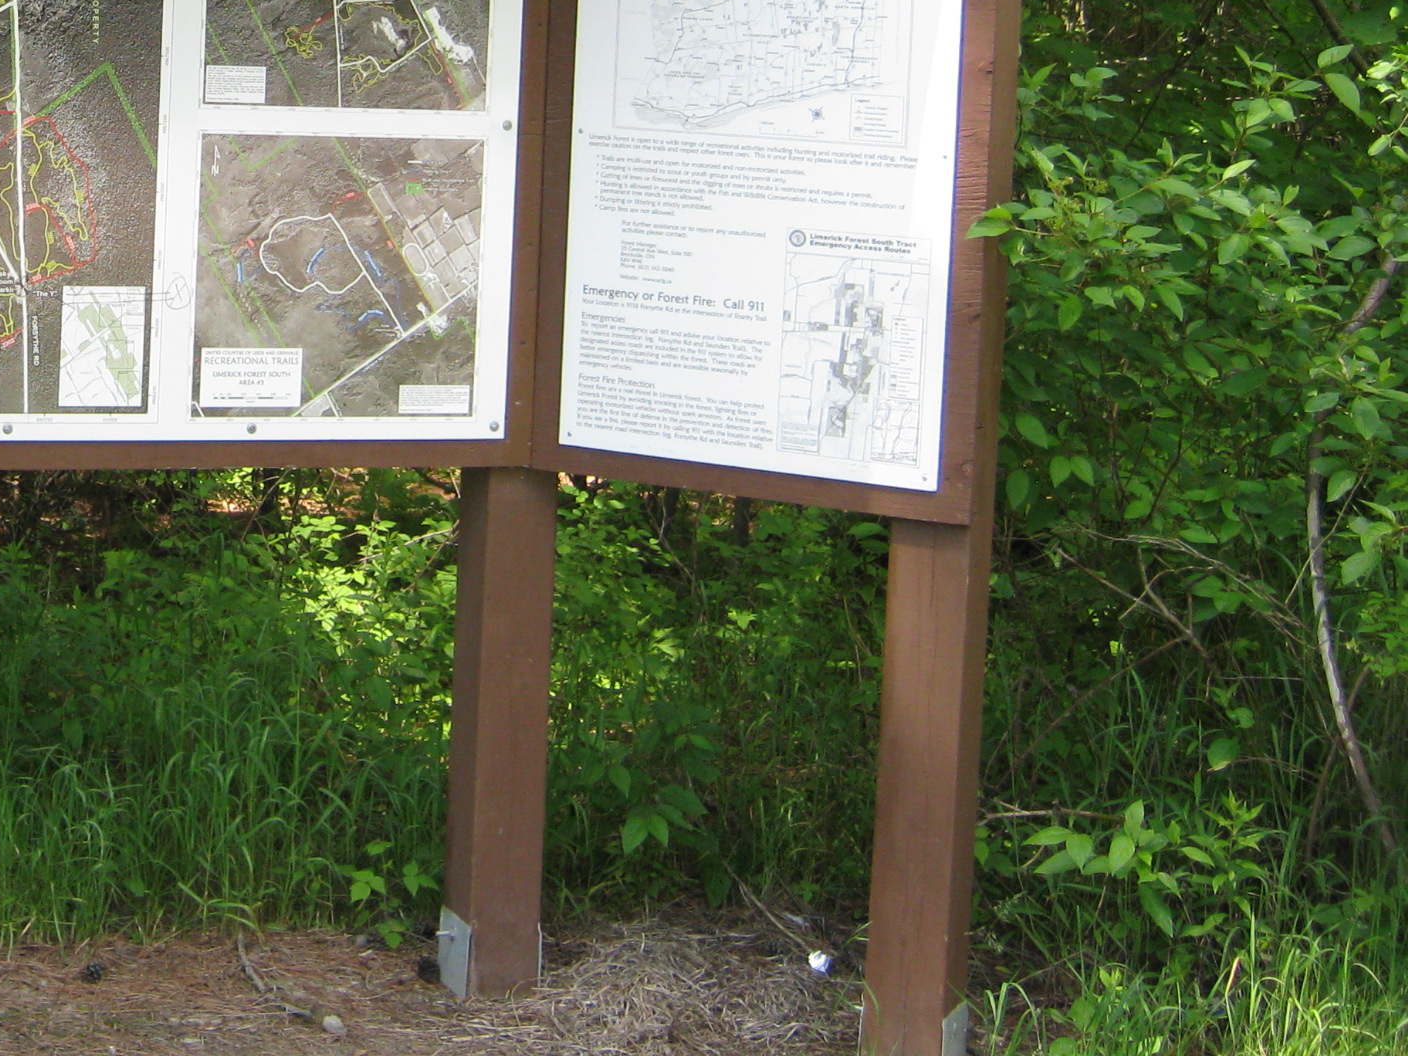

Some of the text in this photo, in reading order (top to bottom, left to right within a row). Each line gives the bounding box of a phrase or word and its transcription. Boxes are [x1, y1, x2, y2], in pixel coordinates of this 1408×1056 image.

[810, 233, 842, 241] Limerick
[845, 236, 869, 244] Forest
[896, 240, 917, 248] Tract
[810, 240, 911, 254] Emergency Access Routes
[582, 284, 639, 301] Emergency
[642, 292, 653, 301] or
[657, 292, 689, 305] Forest
[693, 296, 716, 307] Fire:
[723, 298, 744, 310] Call
[748, 300, 764, 312] 911
[581, 312, 626, 323] Emergencies
[578, 373, 655, 388] Forest Fire Protection
